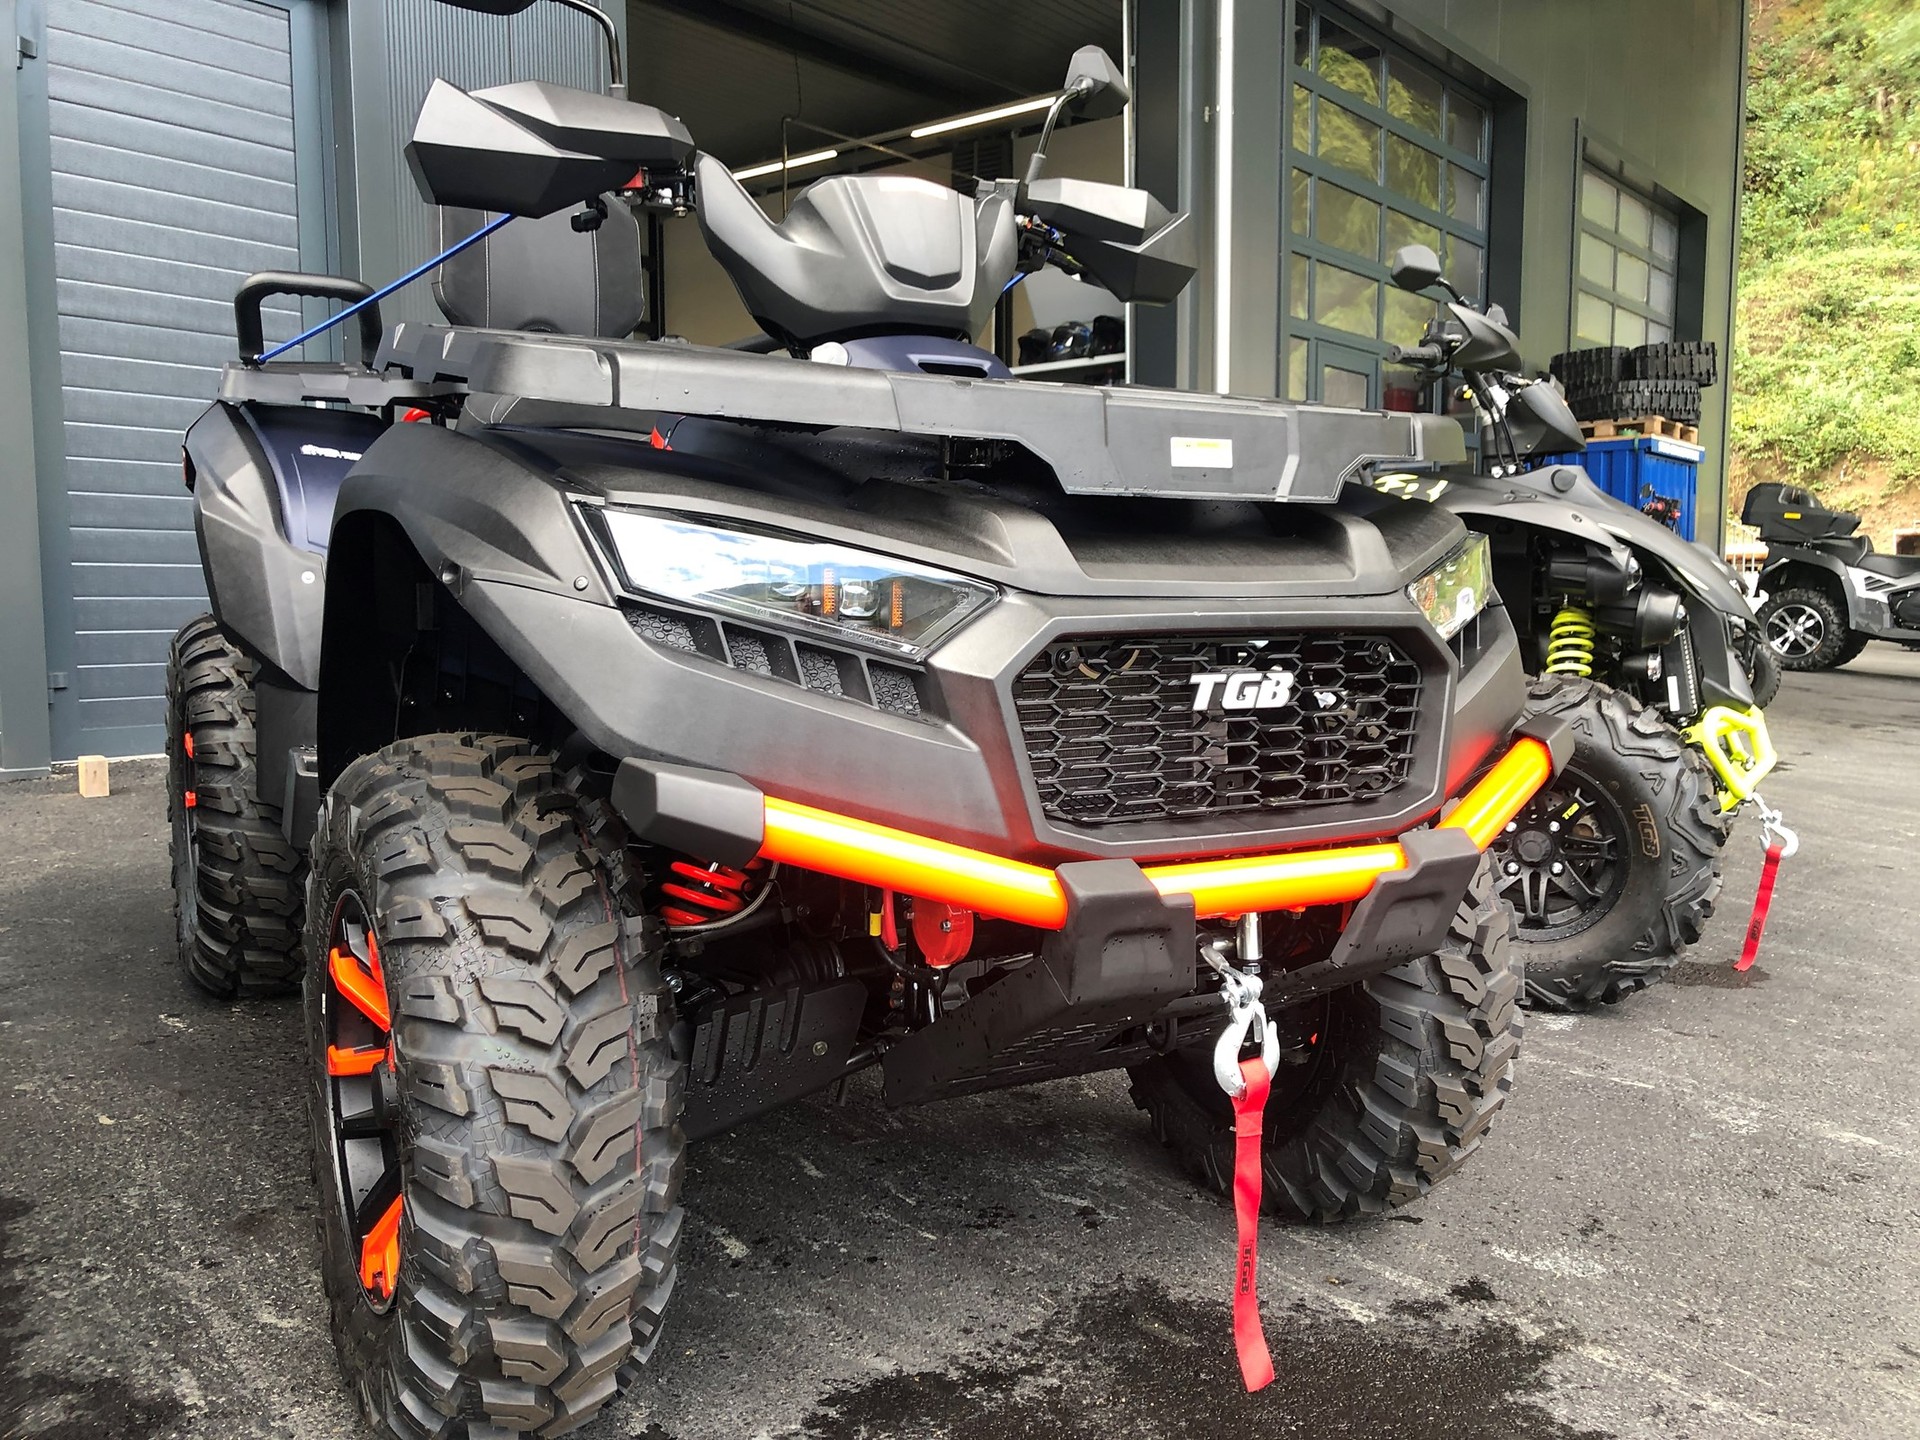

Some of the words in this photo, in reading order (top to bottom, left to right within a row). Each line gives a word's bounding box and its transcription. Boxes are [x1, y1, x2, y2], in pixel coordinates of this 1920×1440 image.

[1189, 671, 1294, 711] TGB
[1632, 803, 1660, 859] TGB
[1240, 1240, 1254, 1296] TGB
